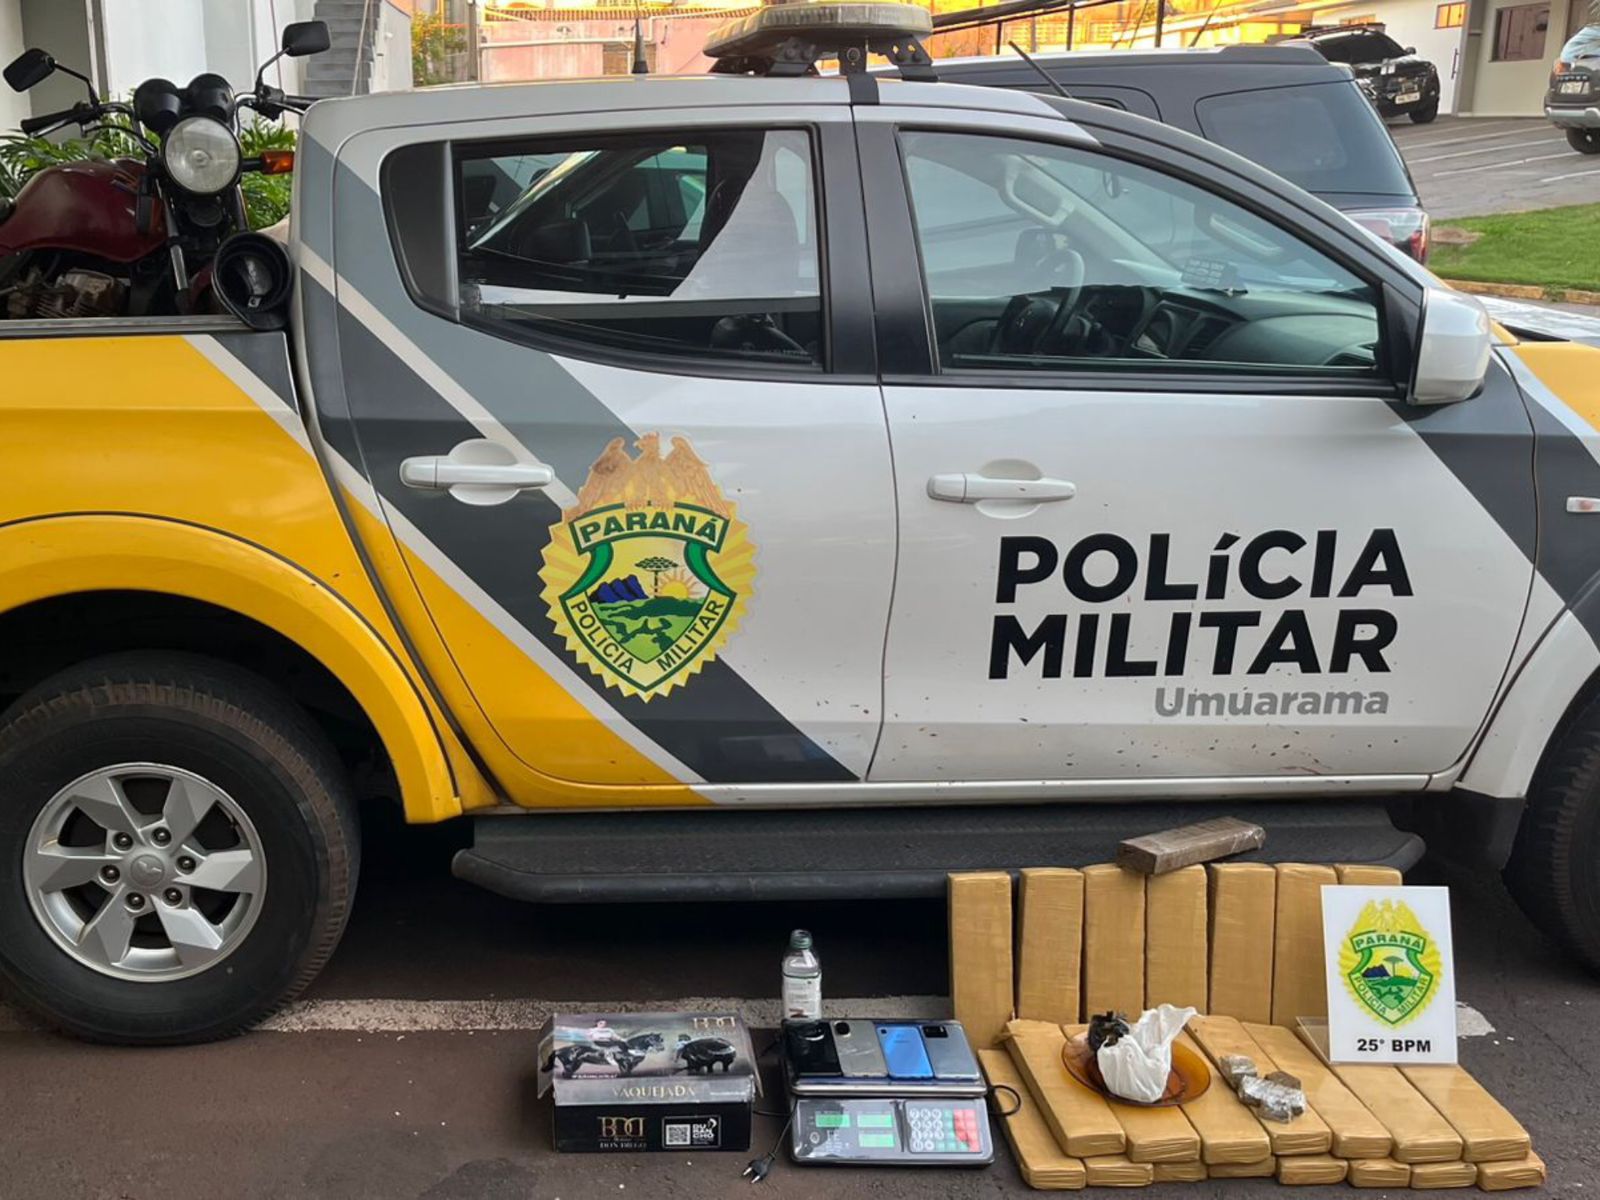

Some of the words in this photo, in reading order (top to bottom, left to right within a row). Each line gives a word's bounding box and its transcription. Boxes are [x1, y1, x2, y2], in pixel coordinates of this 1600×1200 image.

[578, 511, 718, 544] PARANÁ
[655, 599, 725, 672] MILITAR
[988, 608, 1399, 680] MILITAR
[1154, 686, 1389, 718] Umuarama
[1397, 976, 1429, 1014] MILITAR
[1392, 1039, 1431, 1053] BPM
[612, 1085, 697, 1098] VAQUEJADA
